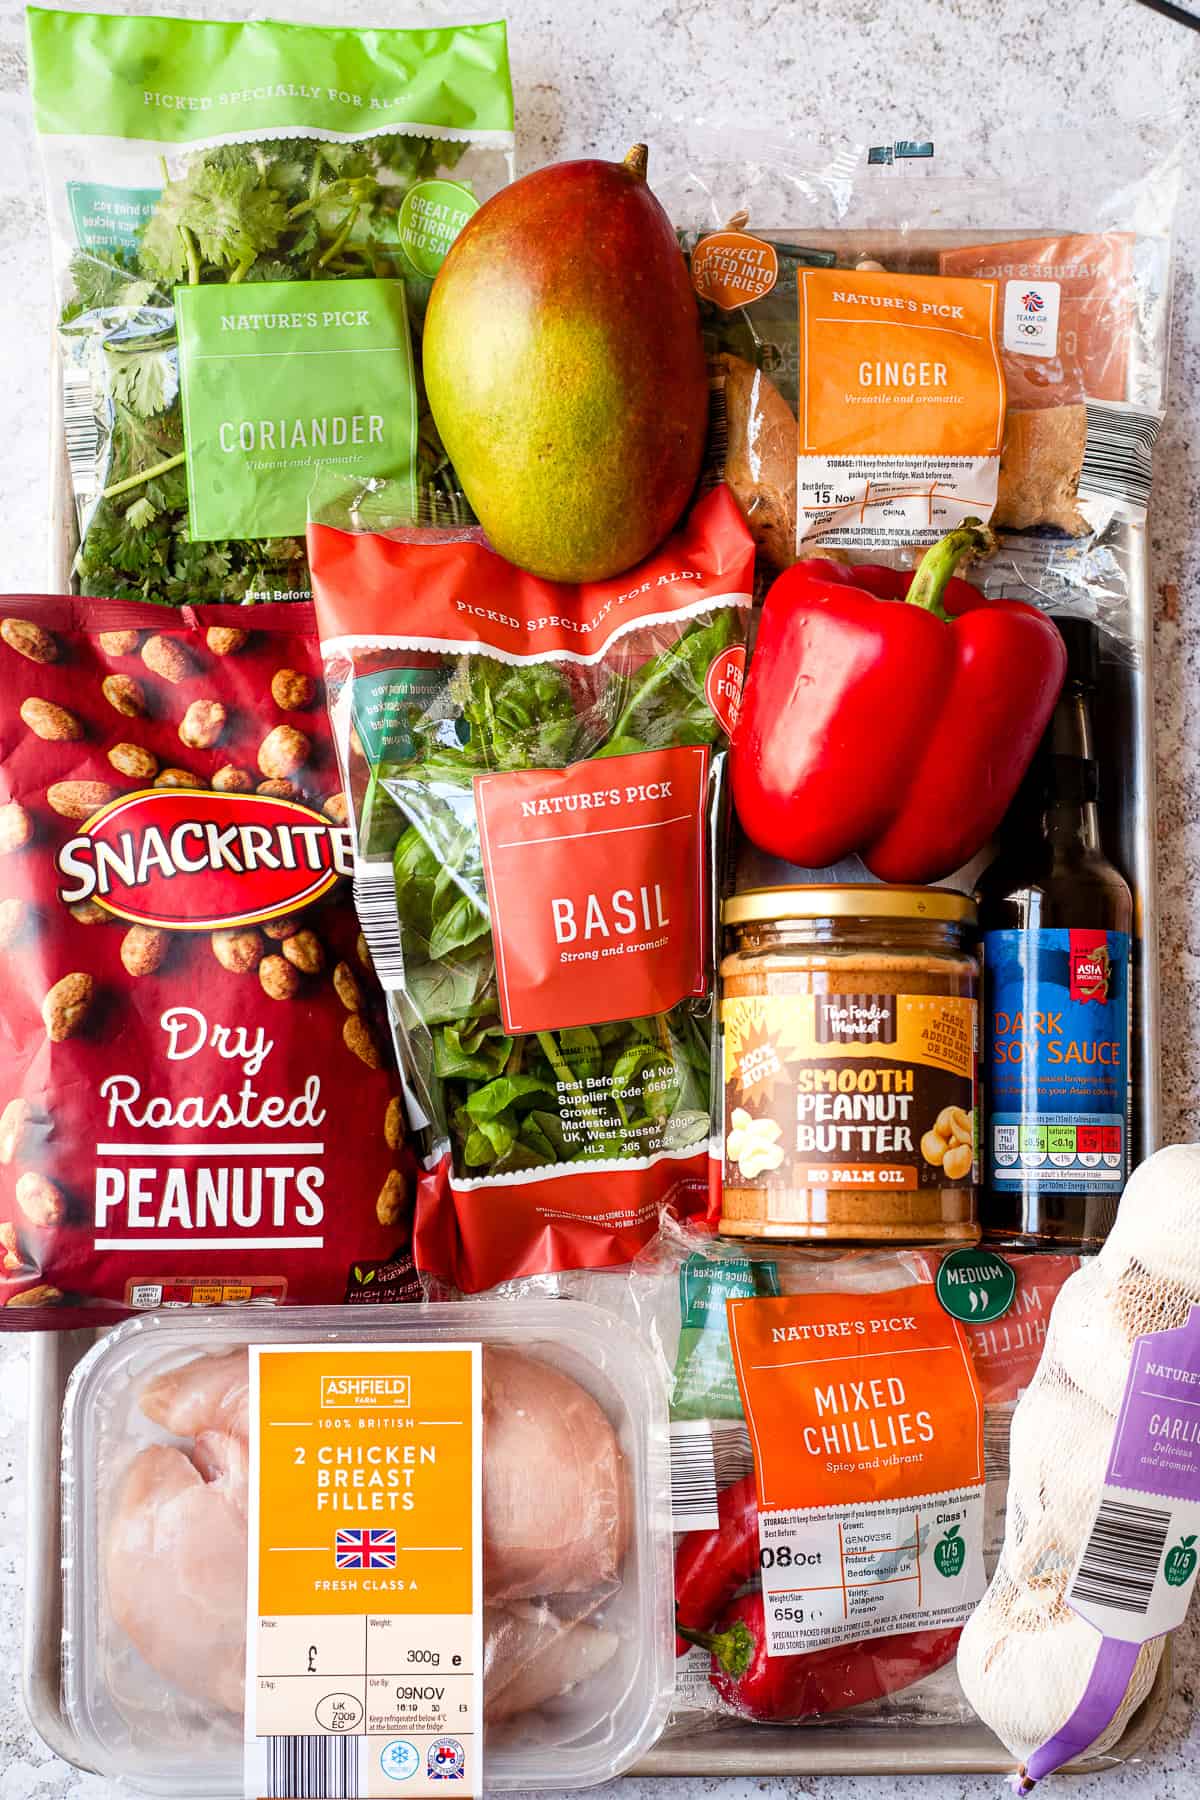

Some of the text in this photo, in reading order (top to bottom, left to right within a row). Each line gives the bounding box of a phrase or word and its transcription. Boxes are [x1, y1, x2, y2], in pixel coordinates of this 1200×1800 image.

[143, 83, 363, 111] PICKED SPECIALLY FOR
[411, 196, 469, 226] GREAT FO
[410, 213, 461, 241] STIRRIN
[402, 226, 427, 248] INTO
[741, 263, 774, 284] INTO
[832, 291, 965, 320] NATURE'S PICK
[220, 310, 370, 331] NATURE'S PICK
[1016, 314, 1035, 322] TEAM
[858, 361, 948, 387] GINGER
[844, 393, 965, 405] Versatile and aromatic
[219, 415, 385, 453] CORIANDER
[291, 455, 312, 468] and
[814, 491, 831, 504] 15
[835, 494, 856, 504] Nov
[882, 509, 906, 517] CHINA
[456, 571, 703, 634] PICKED SPECIALLY FOR ALDI
[520, 781, 673, 817] NATURE'S PICK
[57, 821, 355, 903] SNACKRITE
[551, 884, 670, 945] BASIL
[560, 936, 669, 964] Strong and aromatic
[1077, 964, 1103, 975] ASIA
[821, 1003, 891, 1021] The Foodie
[941, 1011, 966, 1029] MADE
[830, 1018, 880, 1036] Market
[932, 1019, 958, 1037] WITH
[993, 1012, 1064, 1036] DARK
[160, 1006, 275, 1077] Dry
[921, 1028, 954, 1047] ADDED
[927, 1042, 941, 1054] OR
[993, 1040, 1121, 1065] SOY SAUCE
[556, 1080, 583, 1092] Best
[641, 1070, 655, 1081] 04
[797, 1068, 914, 1094] SMOOTH
[100, 1074, 327, 1129] Roasted
[557, 1092, 608, 1106] Supplier
[610, 1086, 645, 1100] Code:
[559, 1105, 608, 1119] Grower:
[796, 1094, 914, 1123] PEANUT
[561, 1117, 623, 1131] Madestein
[998, 1128, 1016, 1136] energy
[562, 1131, 586, 1144] UK,
[587, 1127, 618, 1141] West
[619, 1124, 662, 1139] Sussex
[796, 1125, 915, 1154] BUTTER
[583, 1141, 641, 1155] HL2 305
[1051, 1137, 1075, 1150] <0.1g
[807, 1169, 905, 1183] NO PALM OIL
[94, 1166, 326, 1230] PEANUTS
[946, 1264, 1004, 1286] MEDIUM
[350, 1290, 381, 1299] HIGH
[383, 1288, 396, 1297] IN
[771, 1316, 918, 1343] NATURE'S PICK
[326, 1379, 406, 1395] ASHFIELD
[813, 1376, 906, 1418] MIXED
[319, 1418, 414, 1429] 100% BRITISH
[803, 1411, 935, 1456] CHILLIES
[294, 1445, 436, 1465] 2 CHICKEN
[826, 1452, 924, 1474] Spicy and vibrant
[1140, 1455, 1199, 1473] and aromatic
[317, 1469, 415, 1488] BREAST
[317, 1492, 415, 1511] FILLETS
[936, 1509, 968, 1524] Class 1
[764, 1530, 777, 1538] Best
[941, 1542, 958, 1559] 1/5
[900, 1563, 912, 1572] UK
[1173, 1551, 1191, 1569] 1/5
[314, 1579, 419, 1591] FRESH CLASS A
[774, 1608, 804, 1624] 65g
[850, 1606, 877, 1616] Fresno
[261, 1618, 393, 1629] Price: Weight:
[772, 1631, 799, 1640] SPECIALLY
[800, 1628, 820, 1638] PACKED
[307, 1645, 318, 1673] £
[405, 1650, 441, 1667] 300g
[396, 1686, 446, 1700] 09NOV
[332, 1701, 346, 1711] UK
[331, 1720, 345, 1729] EC
[369, 1714, 384, 1723] Keep
[384, 1713, 417, 1723] refrigerated
[418, 1713, 436, 1723] below
[376, 1722, 386, 1730] the
[386, 1721, 408, 1730] bottom
[415, 1721, 426, 1730] the
[426, 1721, 444, 1732] fridge
